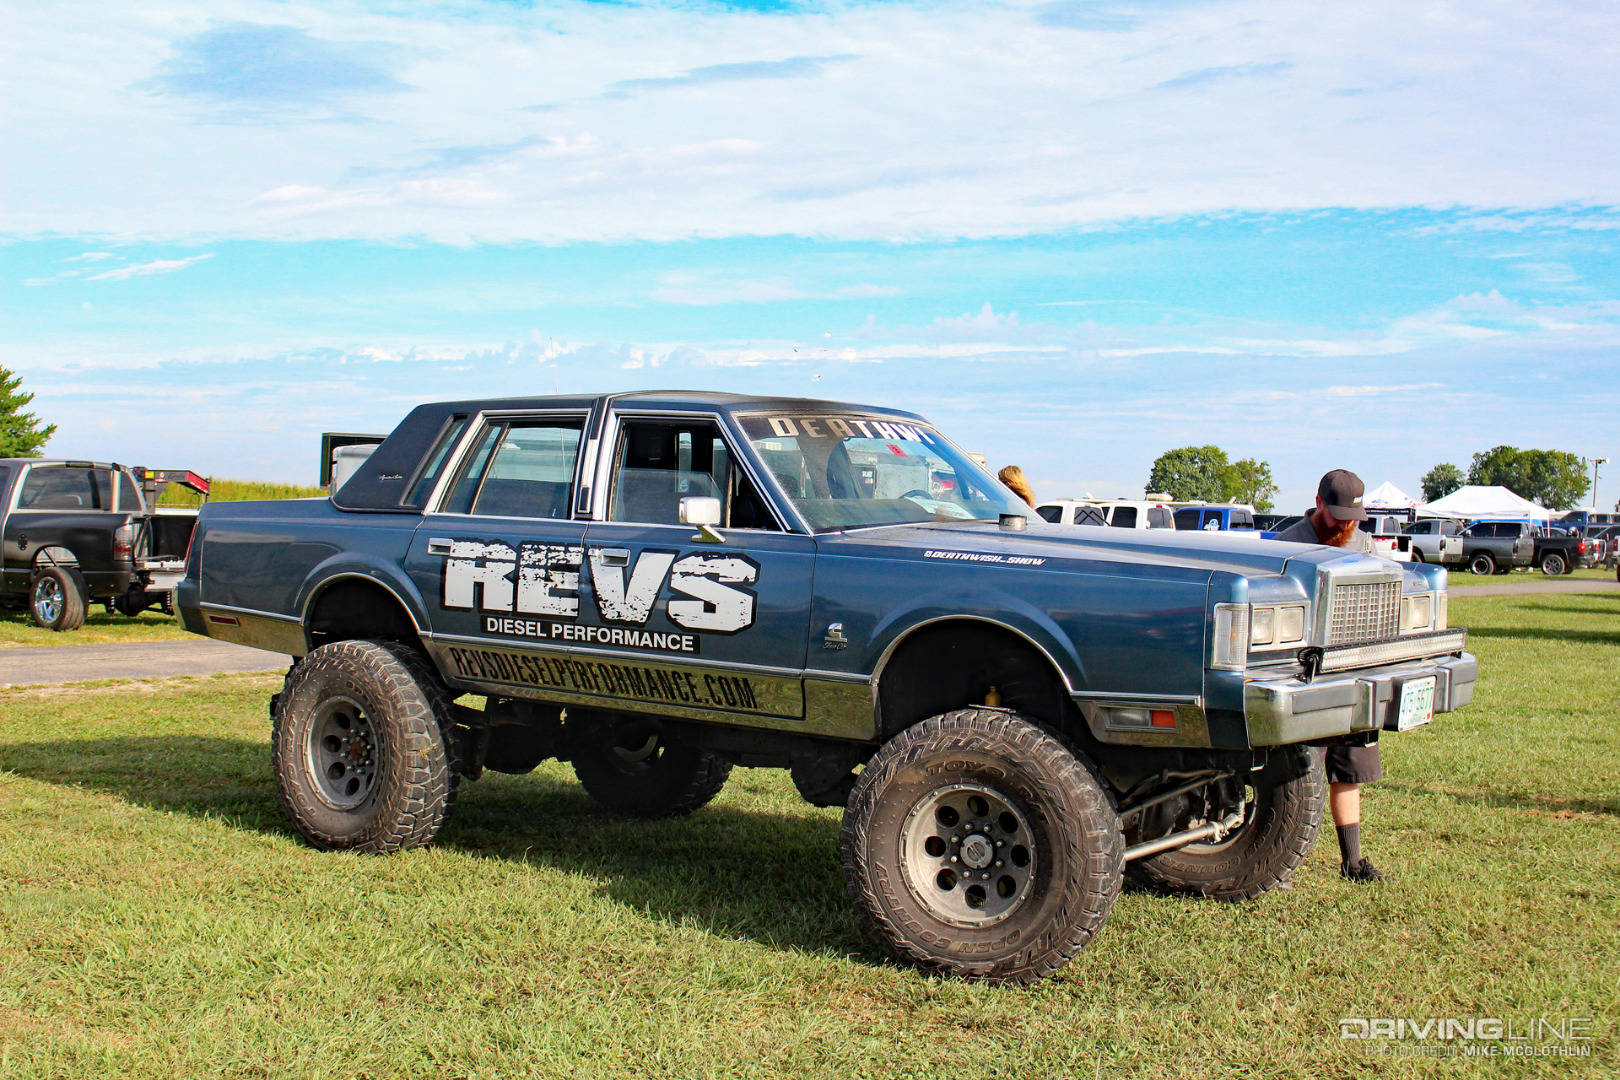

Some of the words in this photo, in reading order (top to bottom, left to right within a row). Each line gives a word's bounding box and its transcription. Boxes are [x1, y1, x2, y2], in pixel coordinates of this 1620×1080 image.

[444, 538, 758, 633] REVS
[486, 616, 547, 638] DIESEL
[551, 624, 694, 651] PERFORMANCE
[448, 647, 758, 709] REVSDIESELPERFORMANCE.COM
[925, 759, 1006, 779] TOYO
[875, 861, 953, 949] COUNTRY
[957, 928, 1022, 955] OPEN
